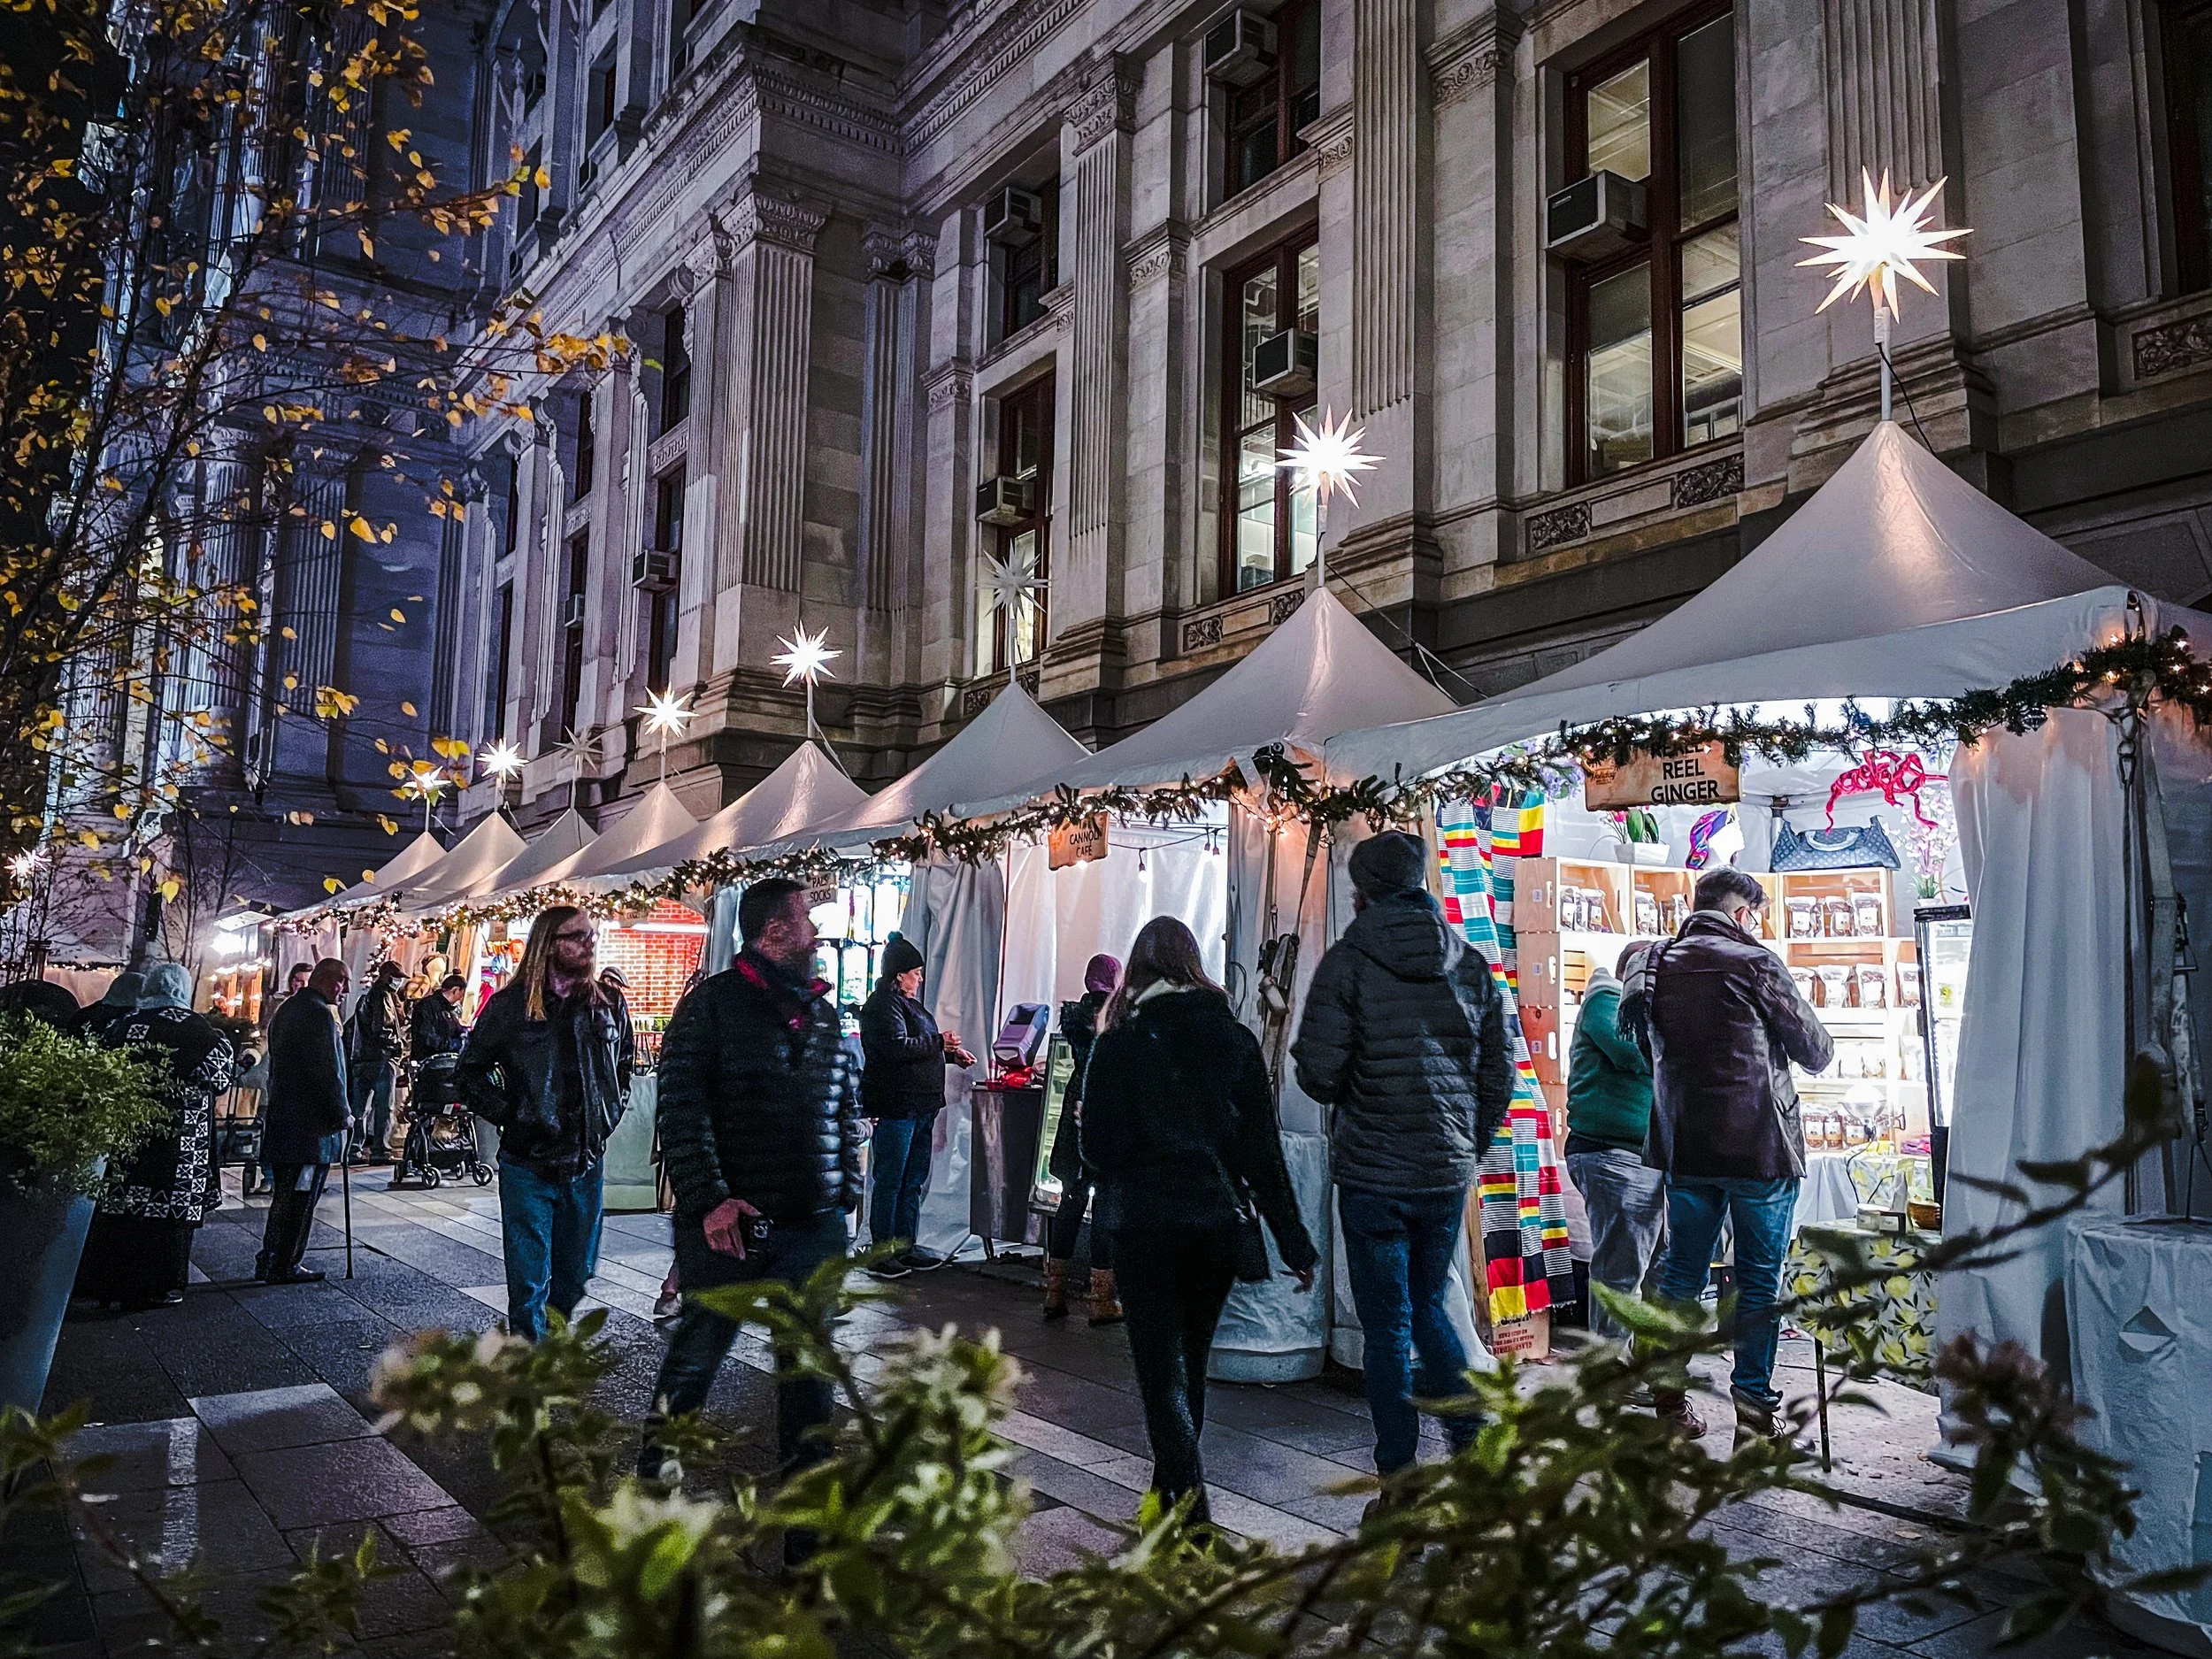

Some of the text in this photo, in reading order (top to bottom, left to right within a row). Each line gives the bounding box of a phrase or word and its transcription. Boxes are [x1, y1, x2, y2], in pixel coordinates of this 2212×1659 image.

[1663, 758, 1704, 780] REEL
[1651, 780, 1719, 803] GINGER
[810, 888, 831, 902] SOCKS
